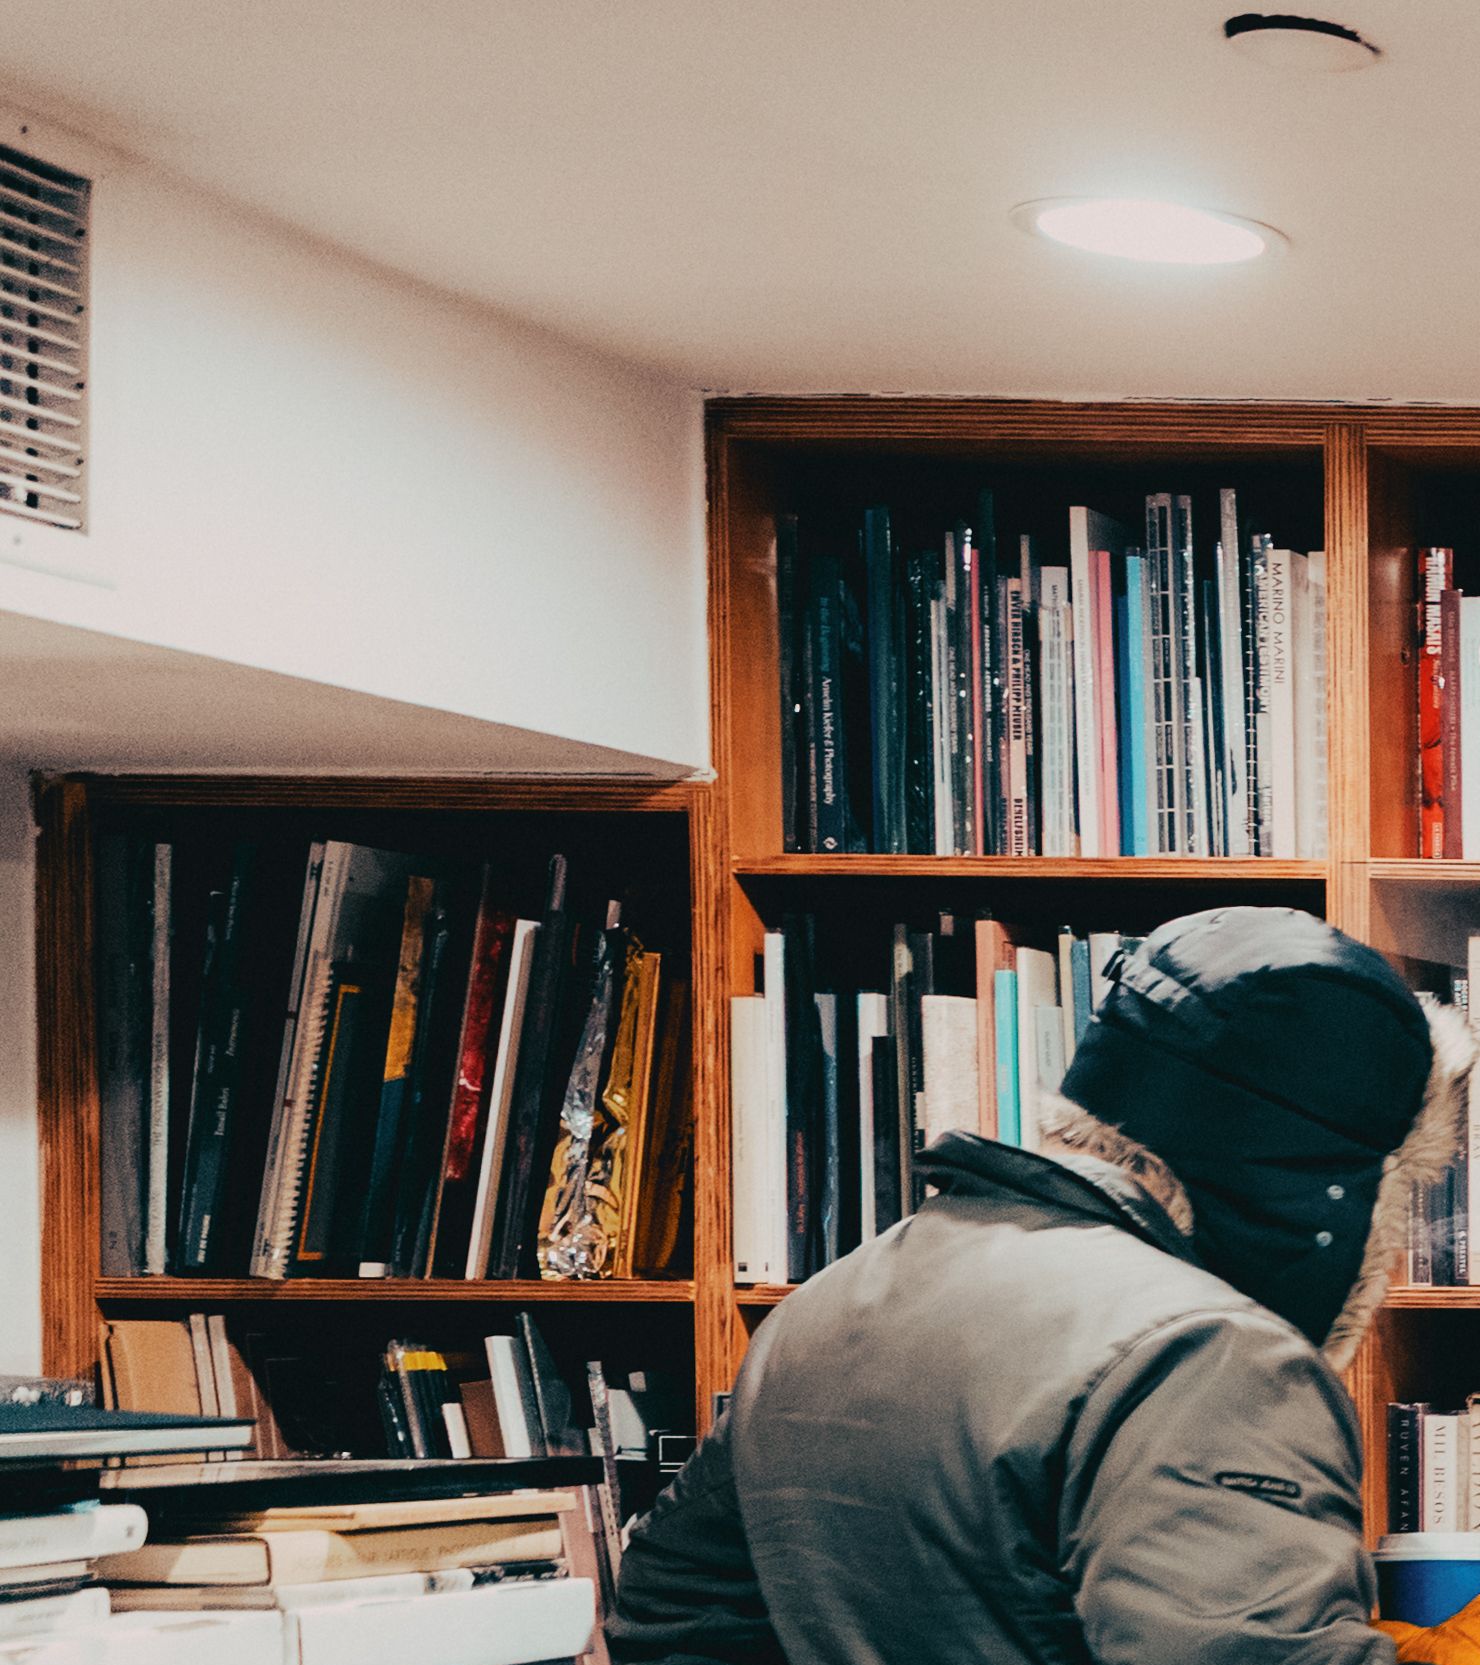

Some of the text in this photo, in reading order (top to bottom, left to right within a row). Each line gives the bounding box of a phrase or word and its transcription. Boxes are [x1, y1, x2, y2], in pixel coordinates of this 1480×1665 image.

[1272, 563, 1286, 684] MARINO MARINI
[1433, 1425, 1446, 1525] MIL BESOS
